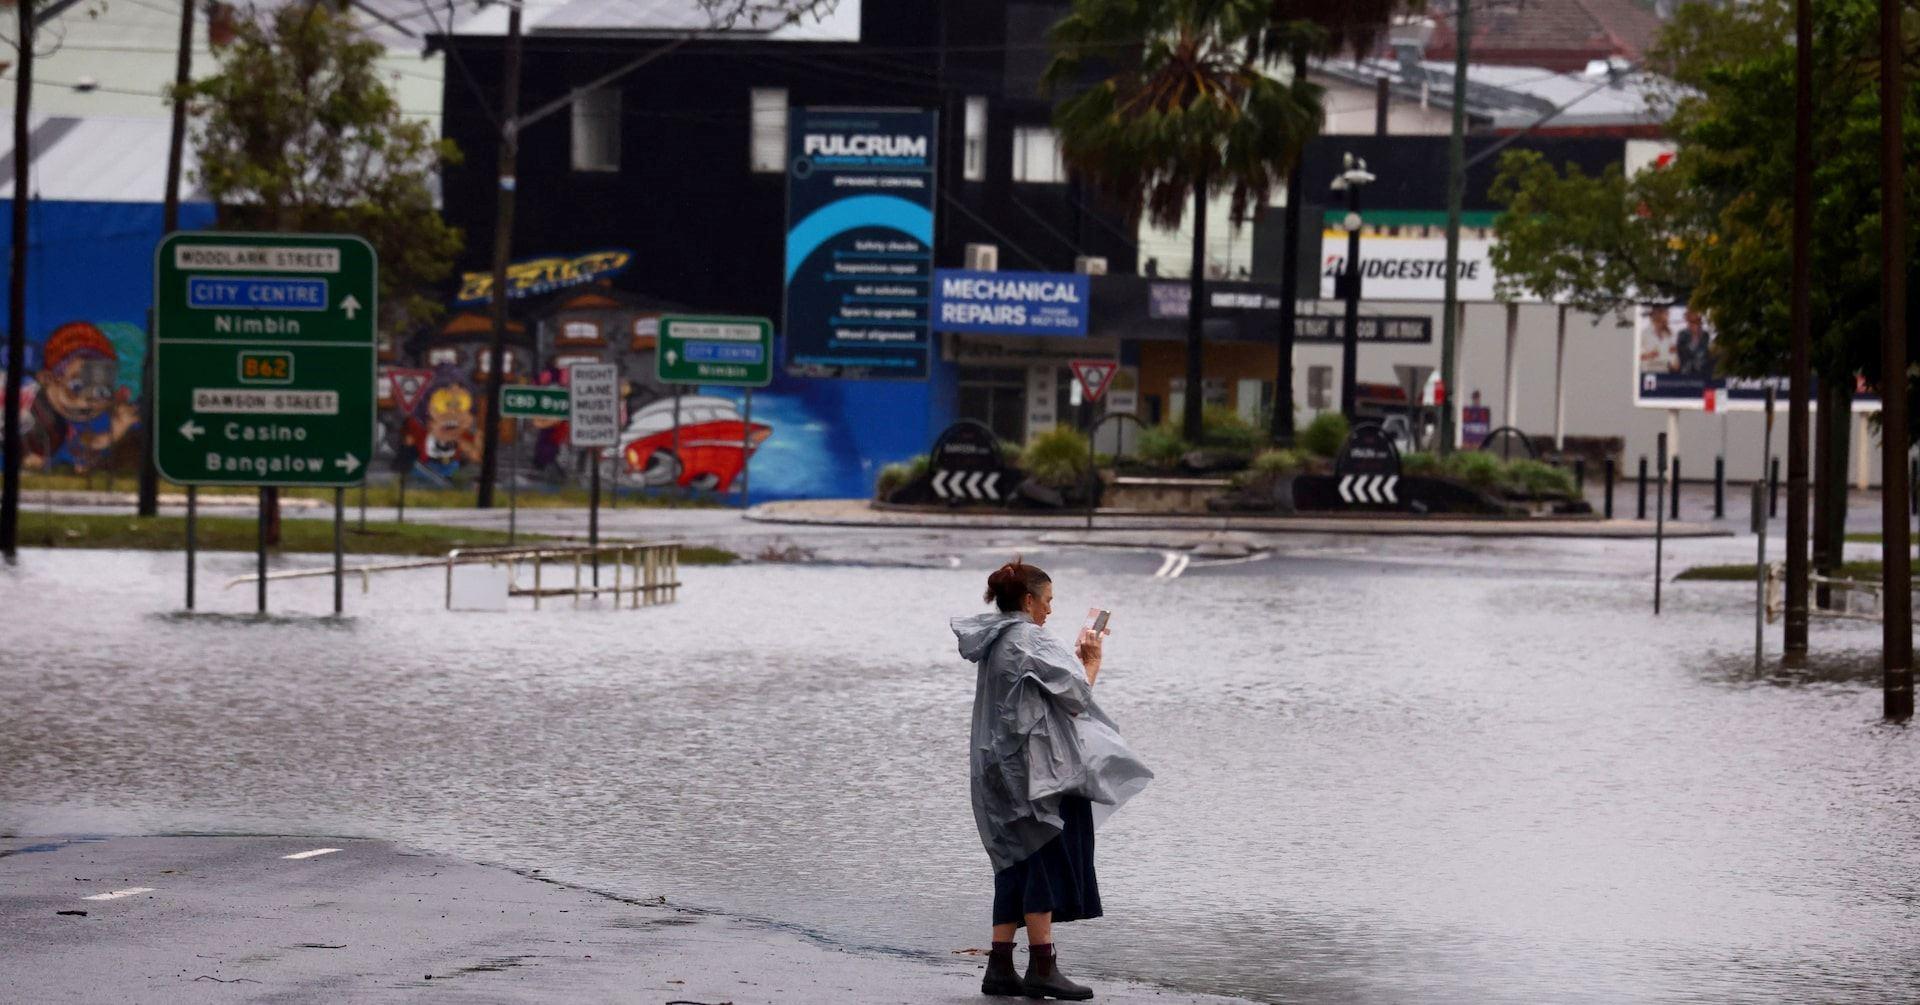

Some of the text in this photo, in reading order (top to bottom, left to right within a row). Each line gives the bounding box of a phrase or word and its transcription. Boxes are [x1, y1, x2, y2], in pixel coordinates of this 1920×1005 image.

[803, 134, 927, 157] FULCRUM
[880, 177, 925, 189] CONTROL
[181, 250, 334, 268] WOODLARK STREET
[1322, 254, 1480, 280] BIDGESTONE
[195, 283, 320, 303] CITY CENTRE
[941, 278, 1080, 303] MECHANICAL
[941, 302, 1027, 326] REPAIRS
[214, 314, 300, 334] Nimbin
[244, 357, 288, 378] B62
[576, 368, 615, 379] RIGHT
[576, 384, 613, 396] LANE
[196, 393, 334, 410] DAWSON STREET
[505, 393, 537, 409] CBD
[576, 400, 614, 411] MUST
[577, 415, 614, 426] TURN
[224, 421, 307, 441] Casino
[576, 429, 614, 440] RIGHT
[206, 452, 324, 477] Bangalow
